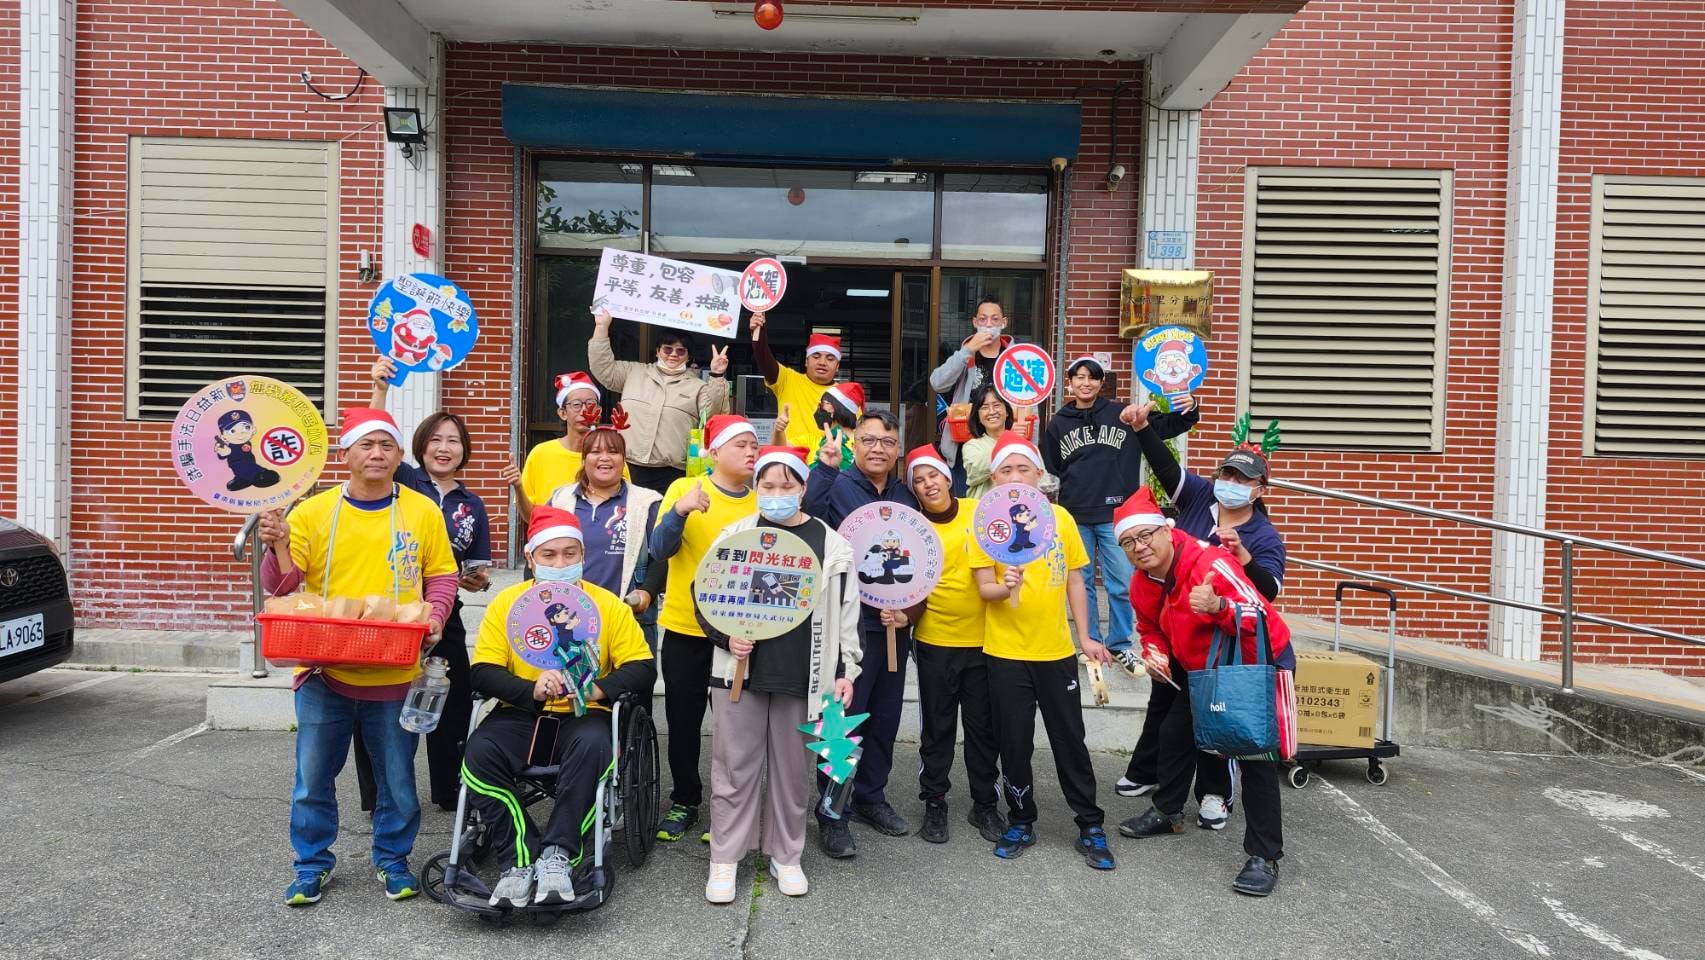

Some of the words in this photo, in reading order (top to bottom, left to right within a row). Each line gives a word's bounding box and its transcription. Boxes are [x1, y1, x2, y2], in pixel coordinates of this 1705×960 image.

[1160, 246, 1182, 257] 398
[396, 275, 471, 320] 聖誕節快樂
[1003, 358, 1046, 393] 超速
[177, 386, 227, 482] 詐騙手法日益新
[1059, 426, 1096, 460] NIKE
[1097, 424, 1127, 450] AIR
[716, 547, 813, 570] 看到閃光紅燈
[698, 592, 746, 606] 請停車再開
[810, 617, 823, 694] BEAUTIFUL
[1210, 701, 1227, 712] hoi!
